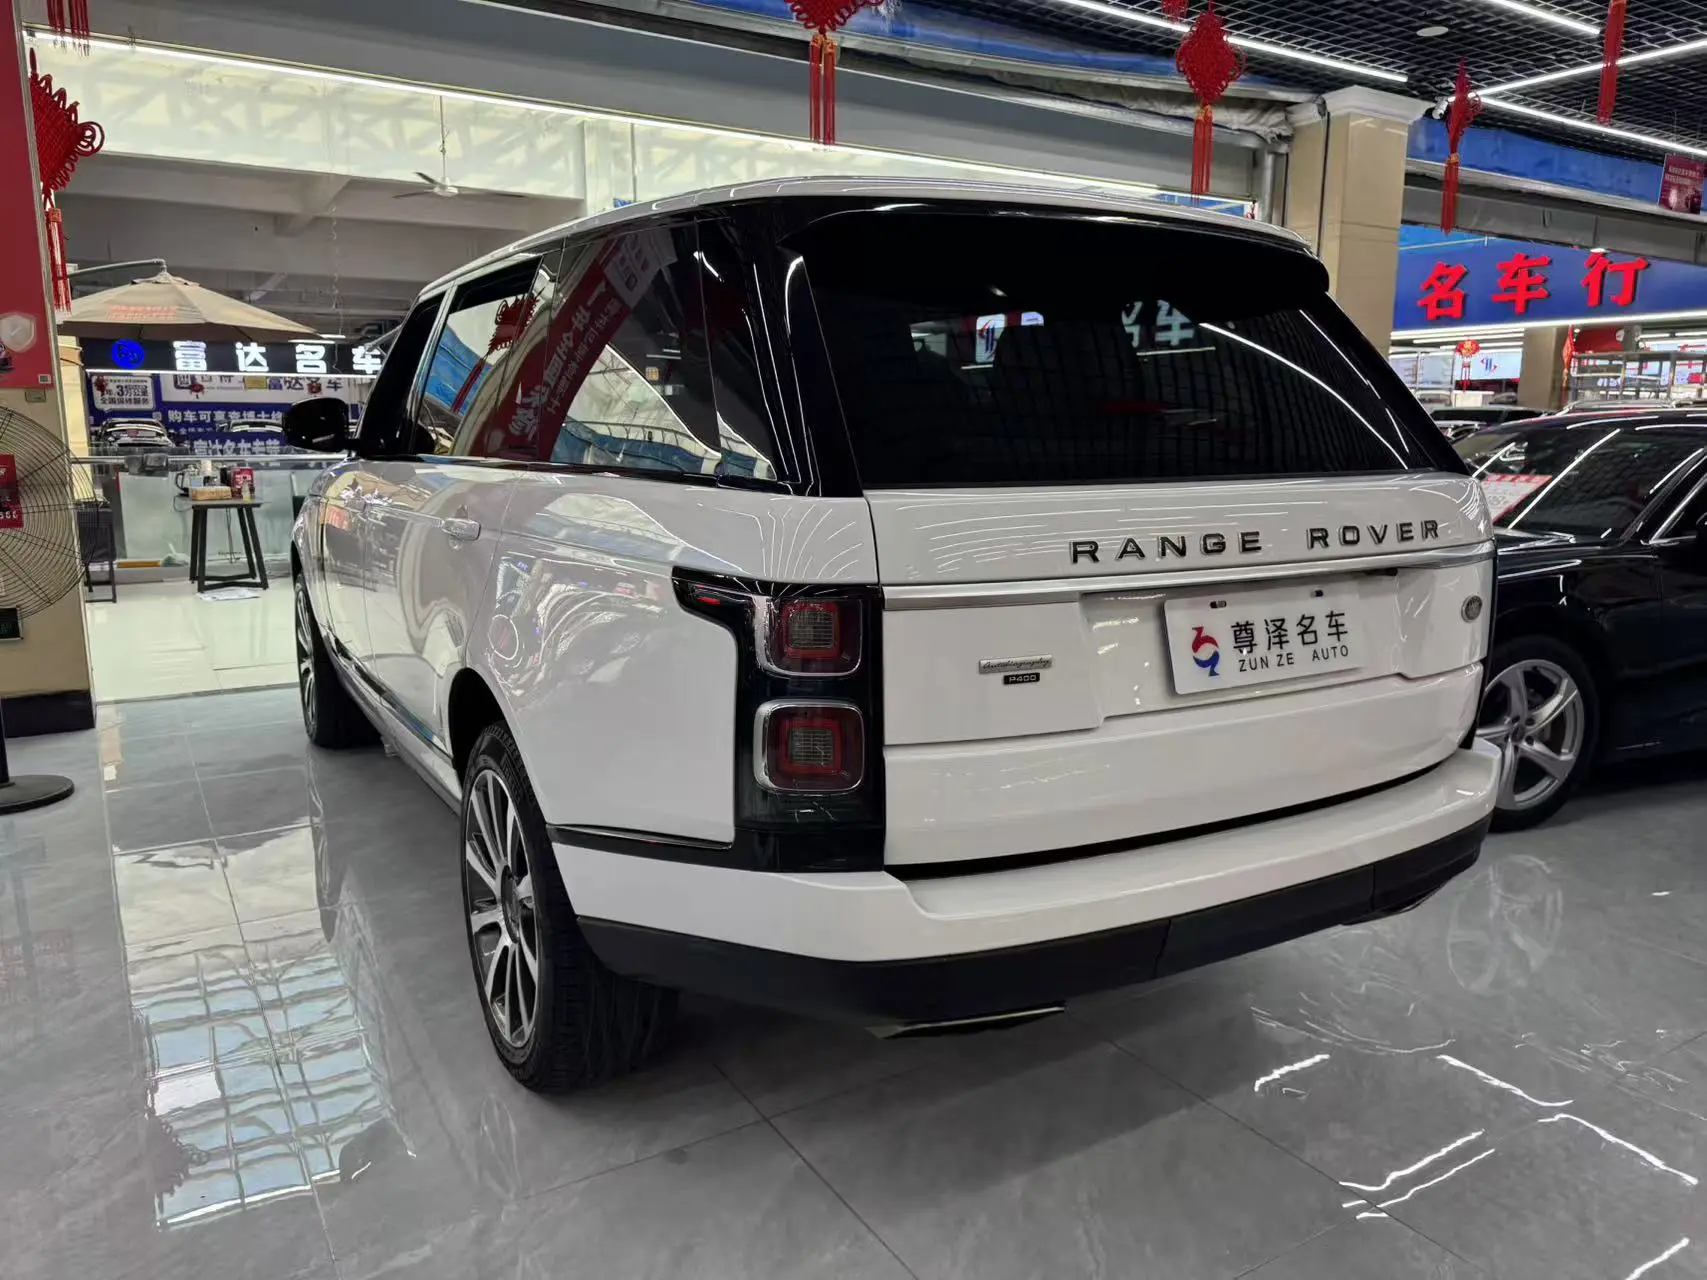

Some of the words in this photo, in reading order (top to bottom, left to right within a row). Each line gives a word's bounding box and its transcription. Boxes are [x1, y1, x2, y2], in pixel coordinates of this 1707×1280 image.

[1417, 251, 1649, 320] 名车行
[172, 340, 383, 374] 富达名车
[1070, 529, 1263, 563] RANGE
[1306, 519, 1440, 549] ROVER
[1230, 610, 1349, 654] 尊泽名车
[1239, 655, 1269, 672] ZUN
[1276, 652, 1295, 667] ZE
[1311, 645, 1349, 661] AUTO
[1008, 674, 1037, 683] P400
